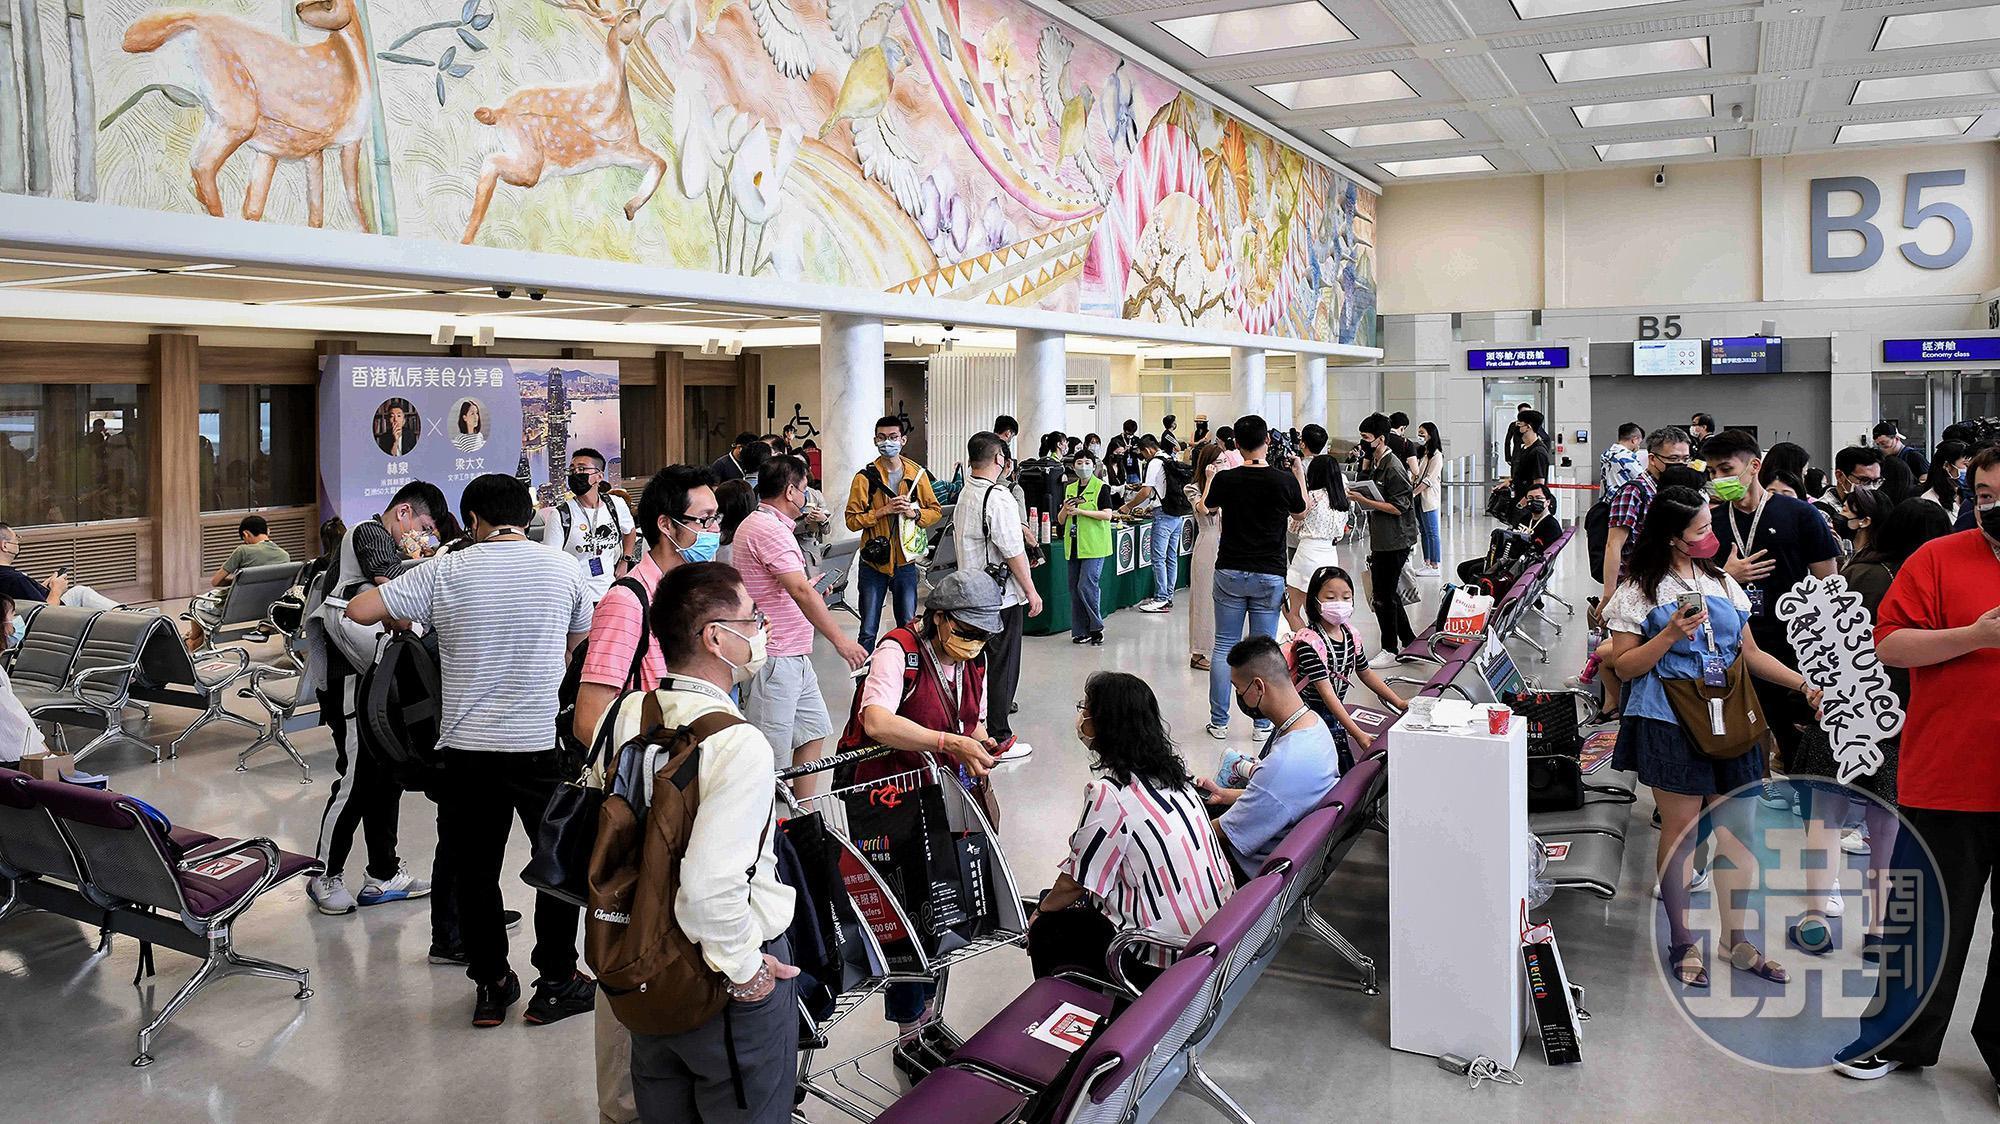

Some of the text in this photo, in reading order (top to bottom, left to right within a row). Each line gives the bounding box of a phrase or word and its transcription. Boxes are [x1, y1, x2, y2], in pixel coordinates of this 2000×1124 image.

[1810, 168, 1974, 274] B5
[1638, 315, 1682, 340] B5
[1922, 341, 1956, 351] 經濟艙
[1922, 351, 1952, 359] Economy
[351, 366, 504, 388] 香港私房美食分享會
[455, 457, 485, 471] 梁大文
[1443, 618, 1473, 632] duty
[1822, 577, 1900, 733] #A330neo
[804, 754, 844, 774] SITTING
[853, 834, 890, 851] verrich
[594, 908, 631, 924] Glenfiddich
[832, 920, 847, 945] Airport
[884, 922, 898, 931] 601
[1528, 954, 1548, 1000] everrich
